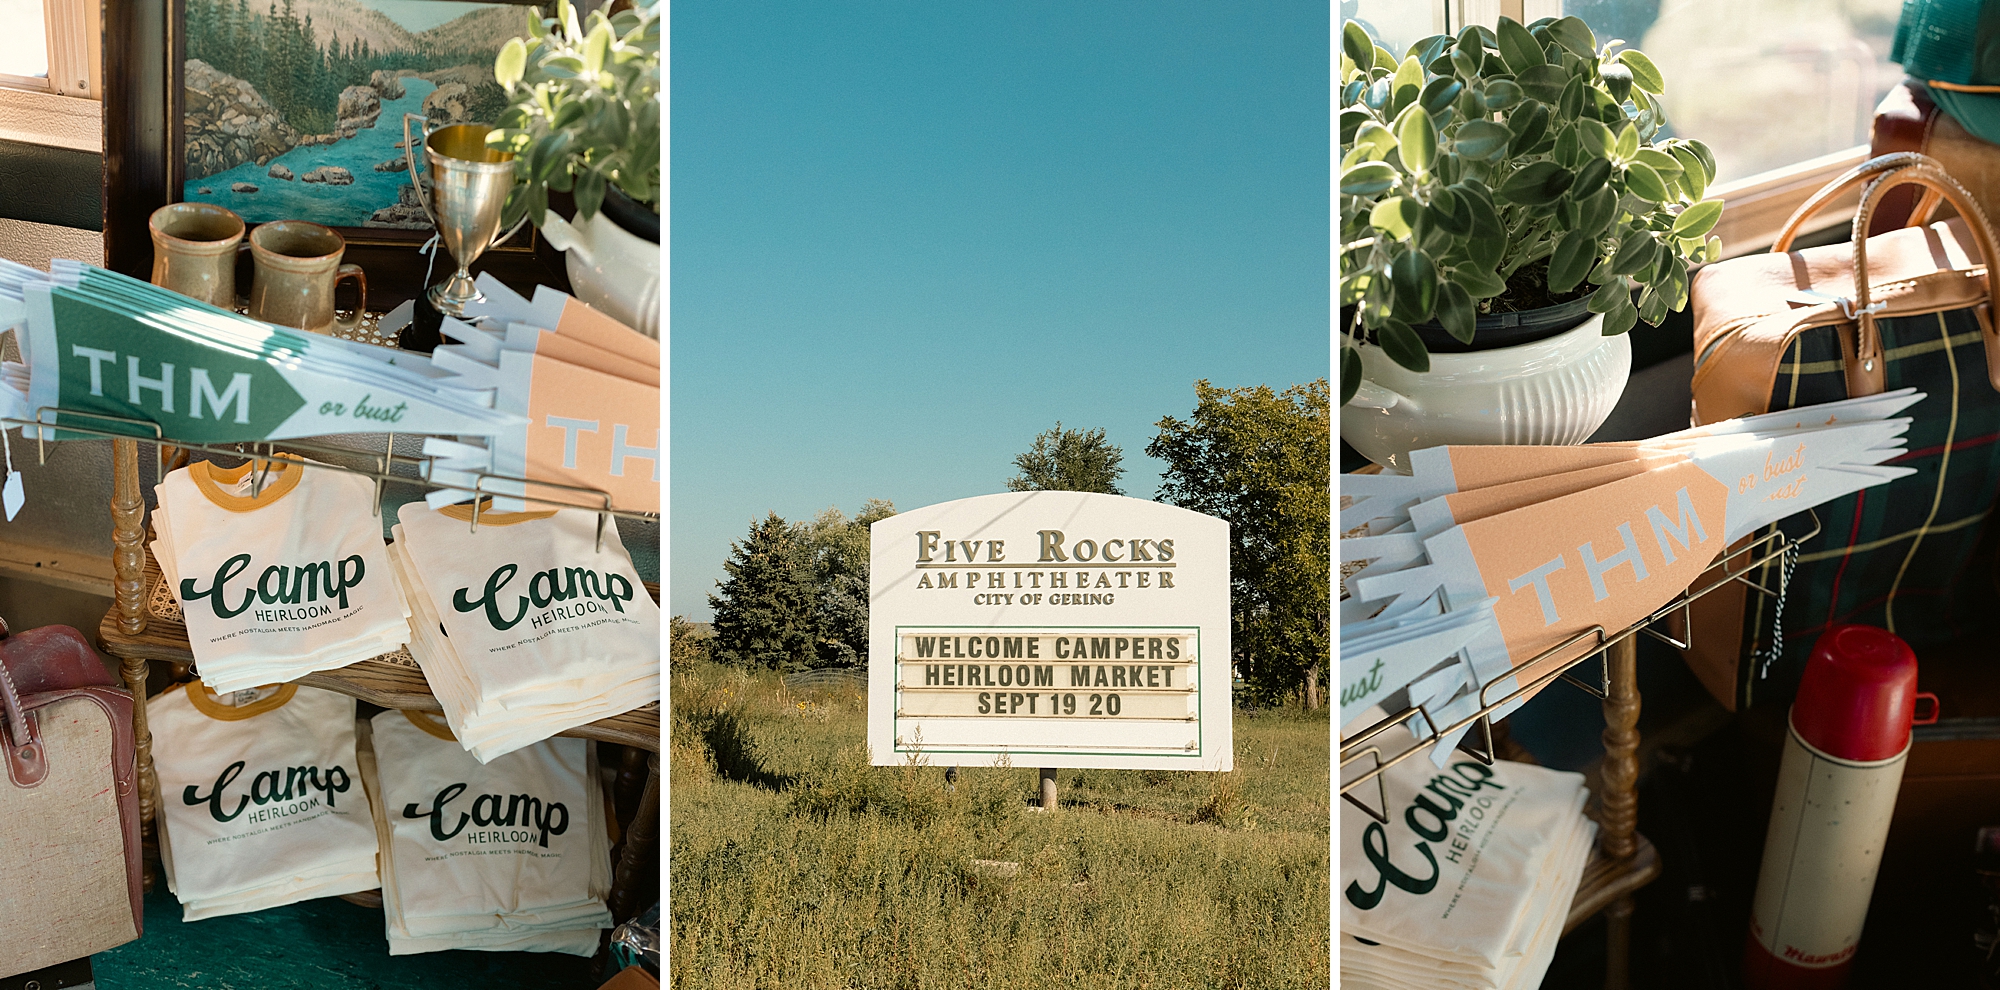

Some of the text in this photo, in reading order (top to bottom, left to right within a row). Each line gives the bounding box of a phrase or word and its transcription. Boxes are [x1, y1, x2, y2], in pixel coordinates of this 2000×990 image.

[72, 344, 252, 425] THM
[319, 393, 408, 423] or bust
[1738, 442, 1807, 494] or bust
[915, 530, 1175, 563] FIVE ROCKS
[1508, 486, 1708, 627] THM
[180, 553, 365, 619] Camp
[453, 563, 634, 631] Camp
[916, 571, 1175, 589] AMPHITHEATER
[255, 605, 332, 622] HEIRLOOM
[974, 593, 1115, 606] CITY OF GERING
[210, 631, 237, 643] WHERE
[239, 627, 276, 636] NOSTALGIA
[302, 616, 341, 631] HANDMADE
[343, 605, 364, 620] MAGIC
[489, 643, 516, 653] WHERE
[518, 630, 556, 646] NOSTALGIA
[557, 625, 580, 633] MEETS
[915, 636, 1180, 659] WELCOME CAMPERS
[926, 664, 1175, 687] HEIRLOOM MARKET
[978, 692, 1121, 715] SEPT 19 20
[183, 761, 351, 822] Camp
[248, 798, 320, 824] HEIRLOOM
[403, 783, 569, 848] Camp
[207, 837, 230, 846] WHERE
[233, 828, 268, 840] NOSTALGIA
[270, 822, 292, 831] MEETS
[293, 811, 328, 825] HANDMADE
[1345, 762, 1506, 910] Camp
